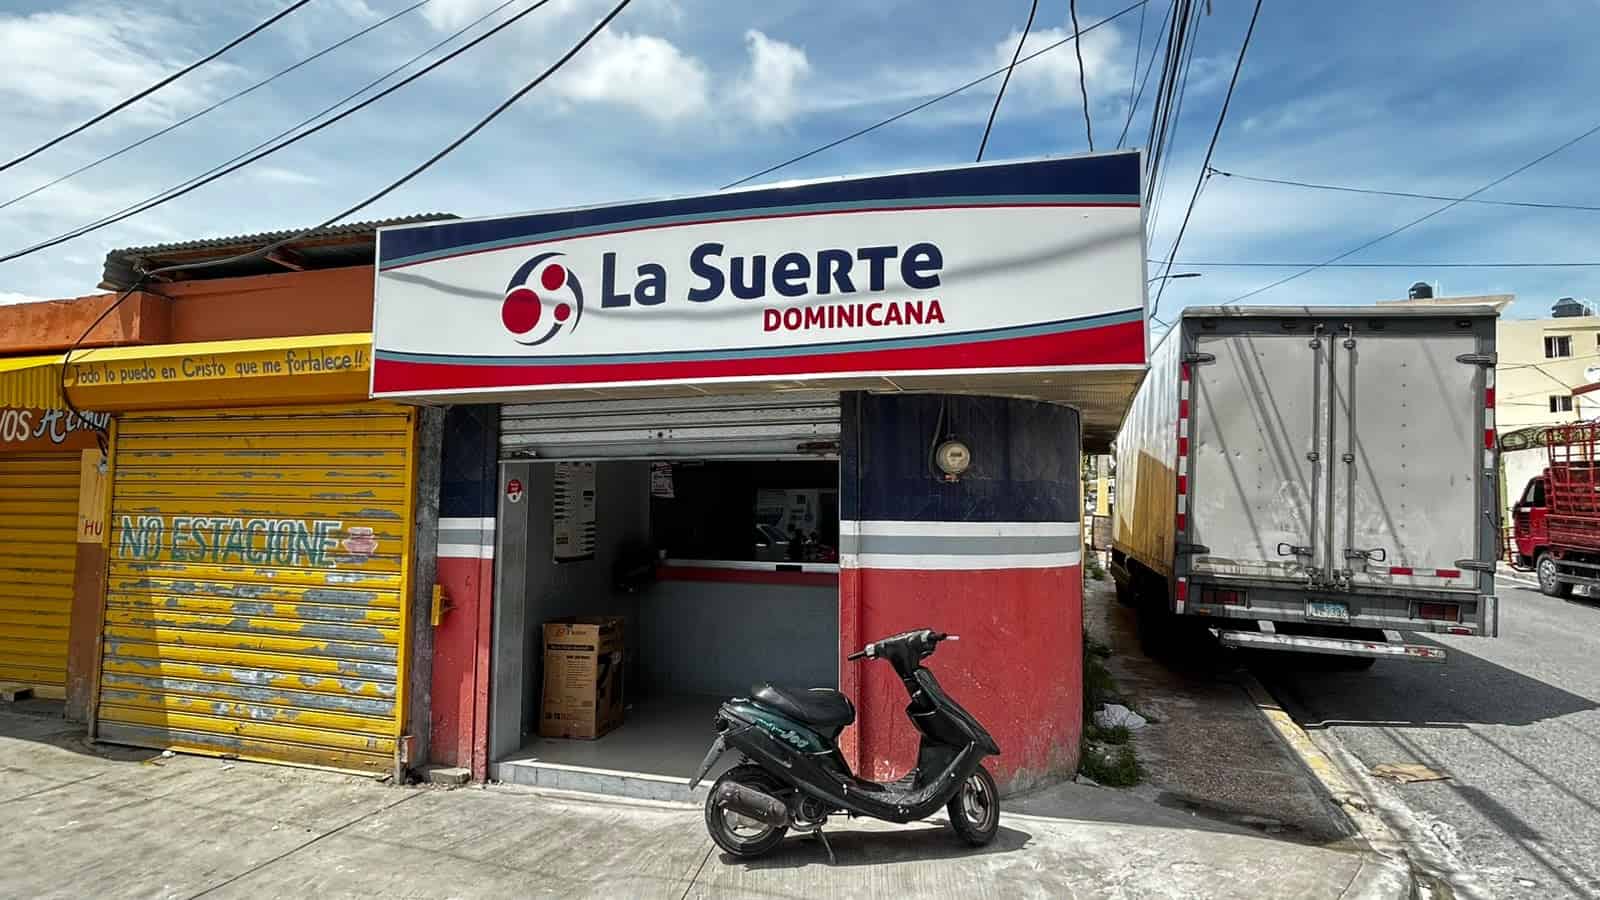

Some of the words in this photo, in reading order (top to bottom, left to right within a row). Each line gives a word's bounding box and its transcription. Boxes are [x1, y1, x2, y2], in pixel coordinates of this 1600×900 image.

[601, 252, 667, 308] La
[763, 299, 945, 332] DOMINICANA
[104, 363, 115, 383] lo
[120, 360, 156, 384] puedo
[161, 367, 176, 379] en
[182, 356, 226, 377] Cristo
[235, 361, 257, 379] que
[263, 360, 282, 374] me
[119, 515, 164, 561] NO
[171, 516, 344, 568] ESTACIONE
